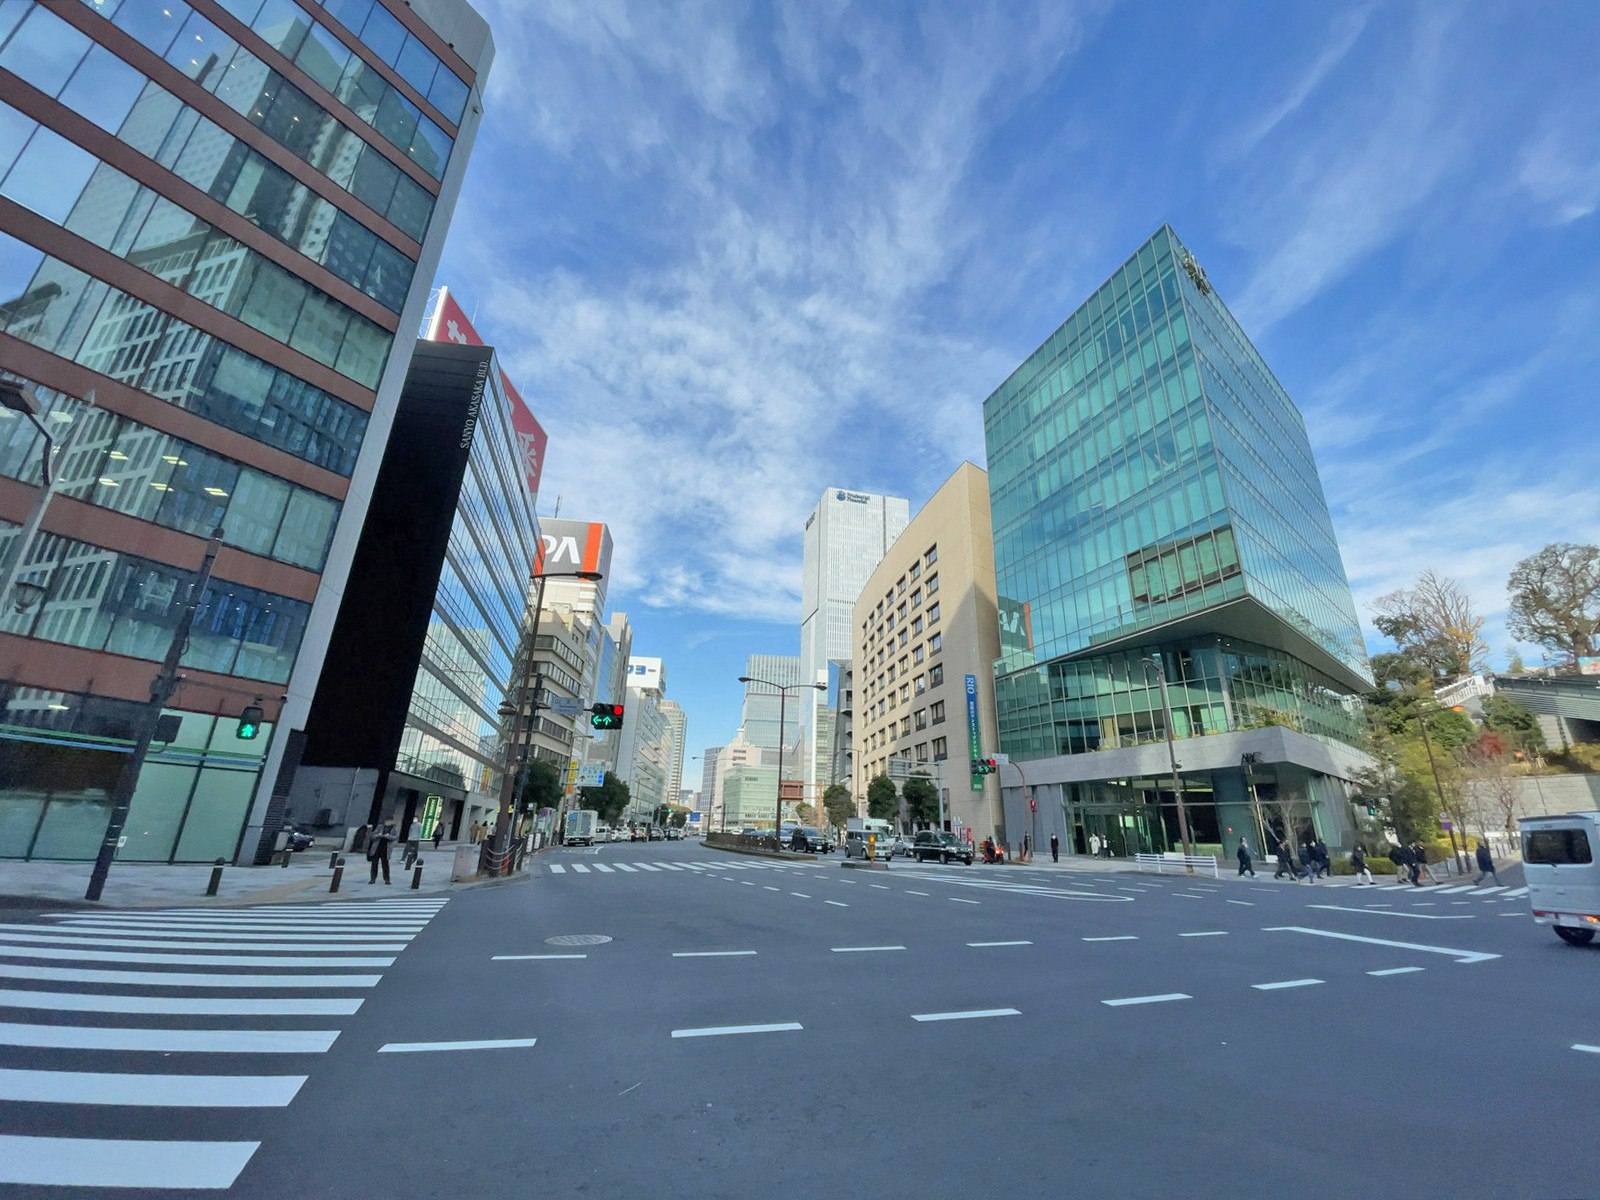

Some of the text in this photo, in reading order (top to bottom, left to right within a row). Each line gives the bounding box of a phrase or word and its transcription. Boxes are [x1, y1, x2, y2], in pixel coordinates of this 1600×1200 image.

[461, 360, 490, 449] SANYO AKASAKA BLD.
[966, 677, 975, 694] RIO
